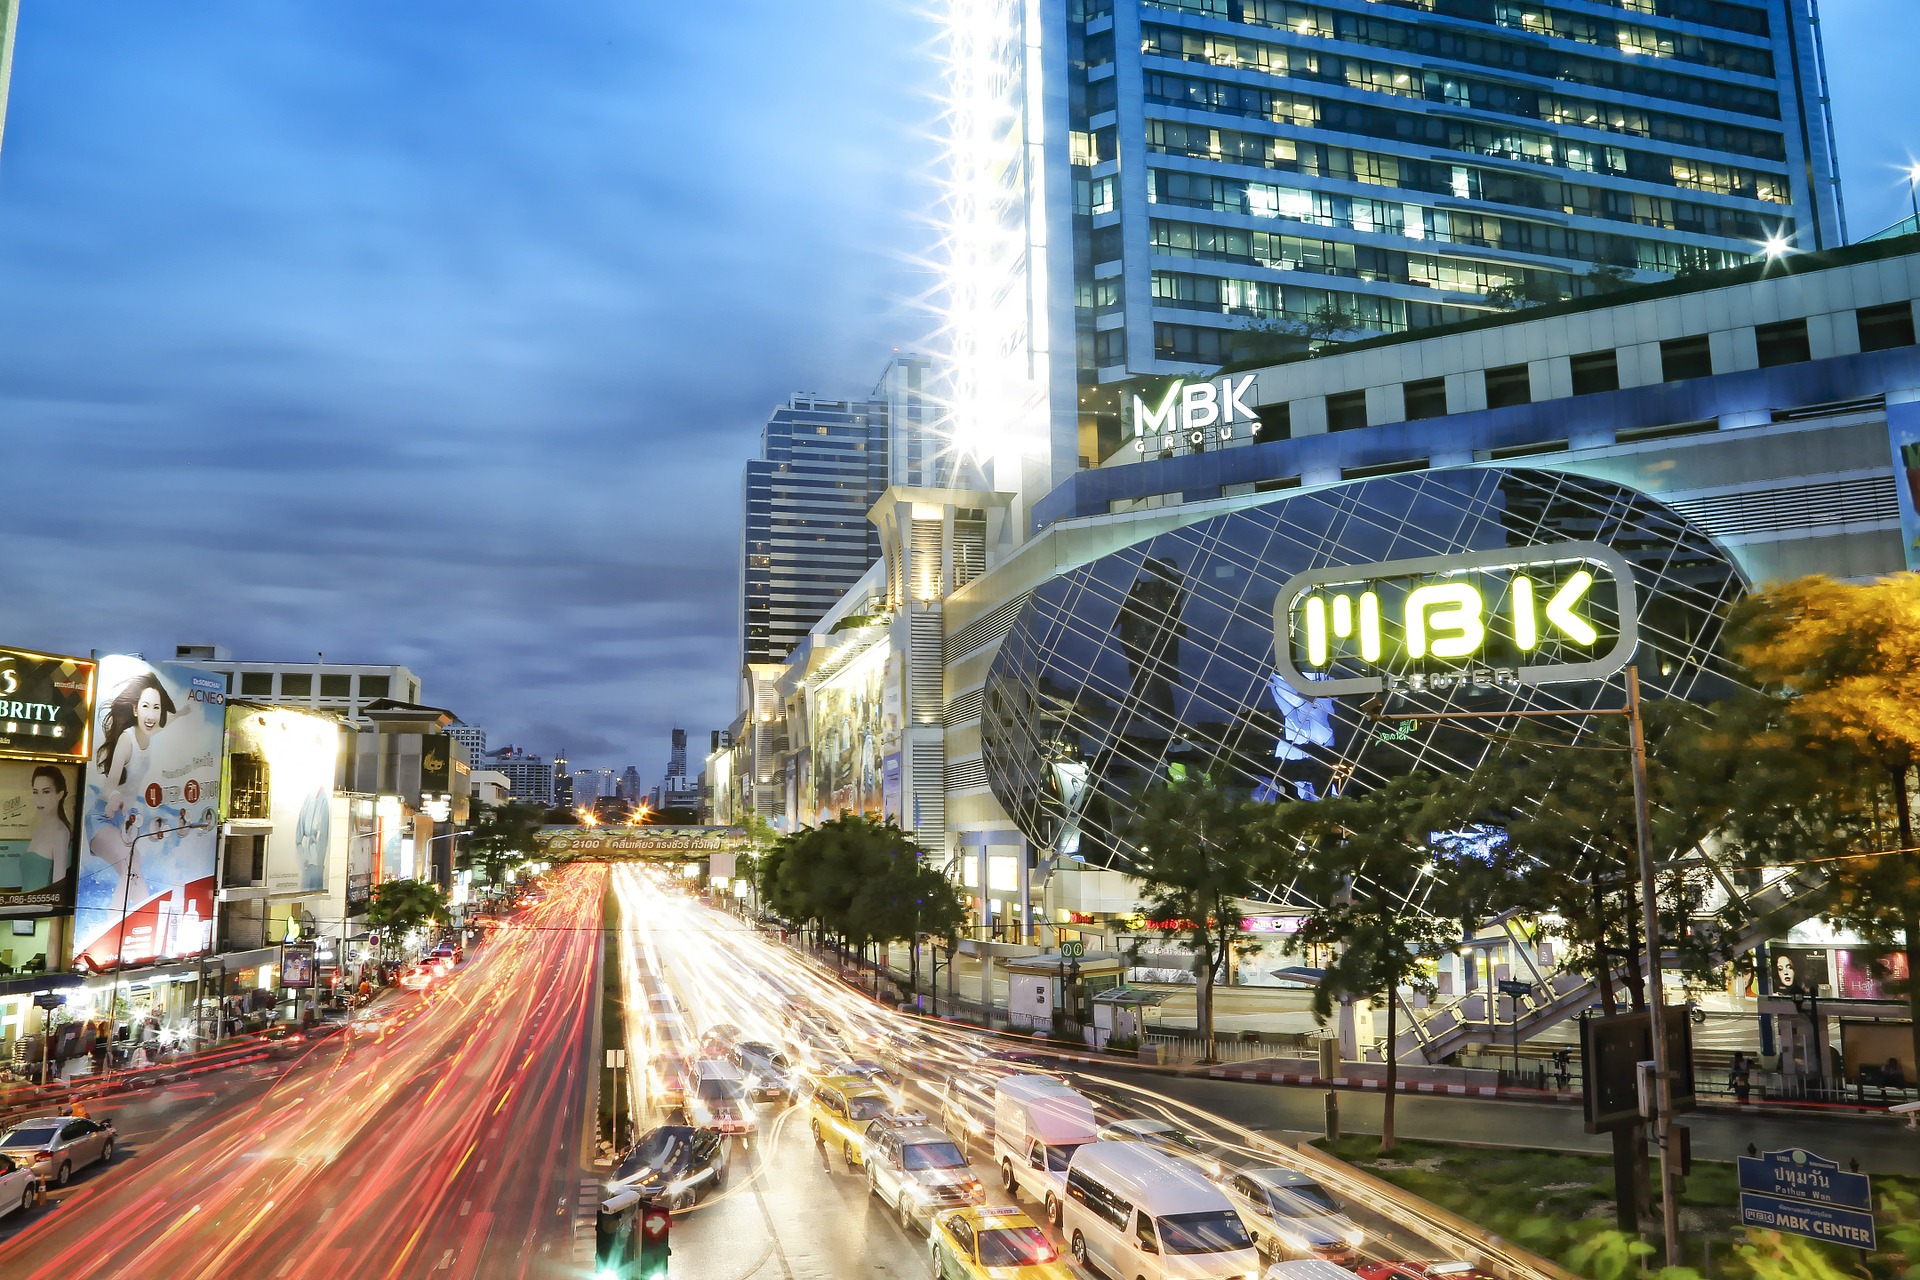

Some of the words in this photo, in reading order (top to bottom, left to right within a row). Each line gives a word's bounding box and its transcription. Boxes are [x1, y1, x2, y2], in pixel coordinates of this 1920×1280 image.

[1133, 373, 1261, 437] MBK
[1134, 422, 1262, 453] GROUP
[1306, 570, 1597, 667] MBK
[1387, 667, 1516, 695] CENTER
[549, 839, 567, 849] 3G
[571, 840, 600, 849] 2100
[611, 837, 654, 849] คลื่นเดียว
[1774, 1167, 1830, 1188] ปทุมวัน
[1812, 1190, 1831, 1201] Wan
[1776, 1213, 1810, 1232] MBK
[1813, 1220, 1871, 1243] CENTER
